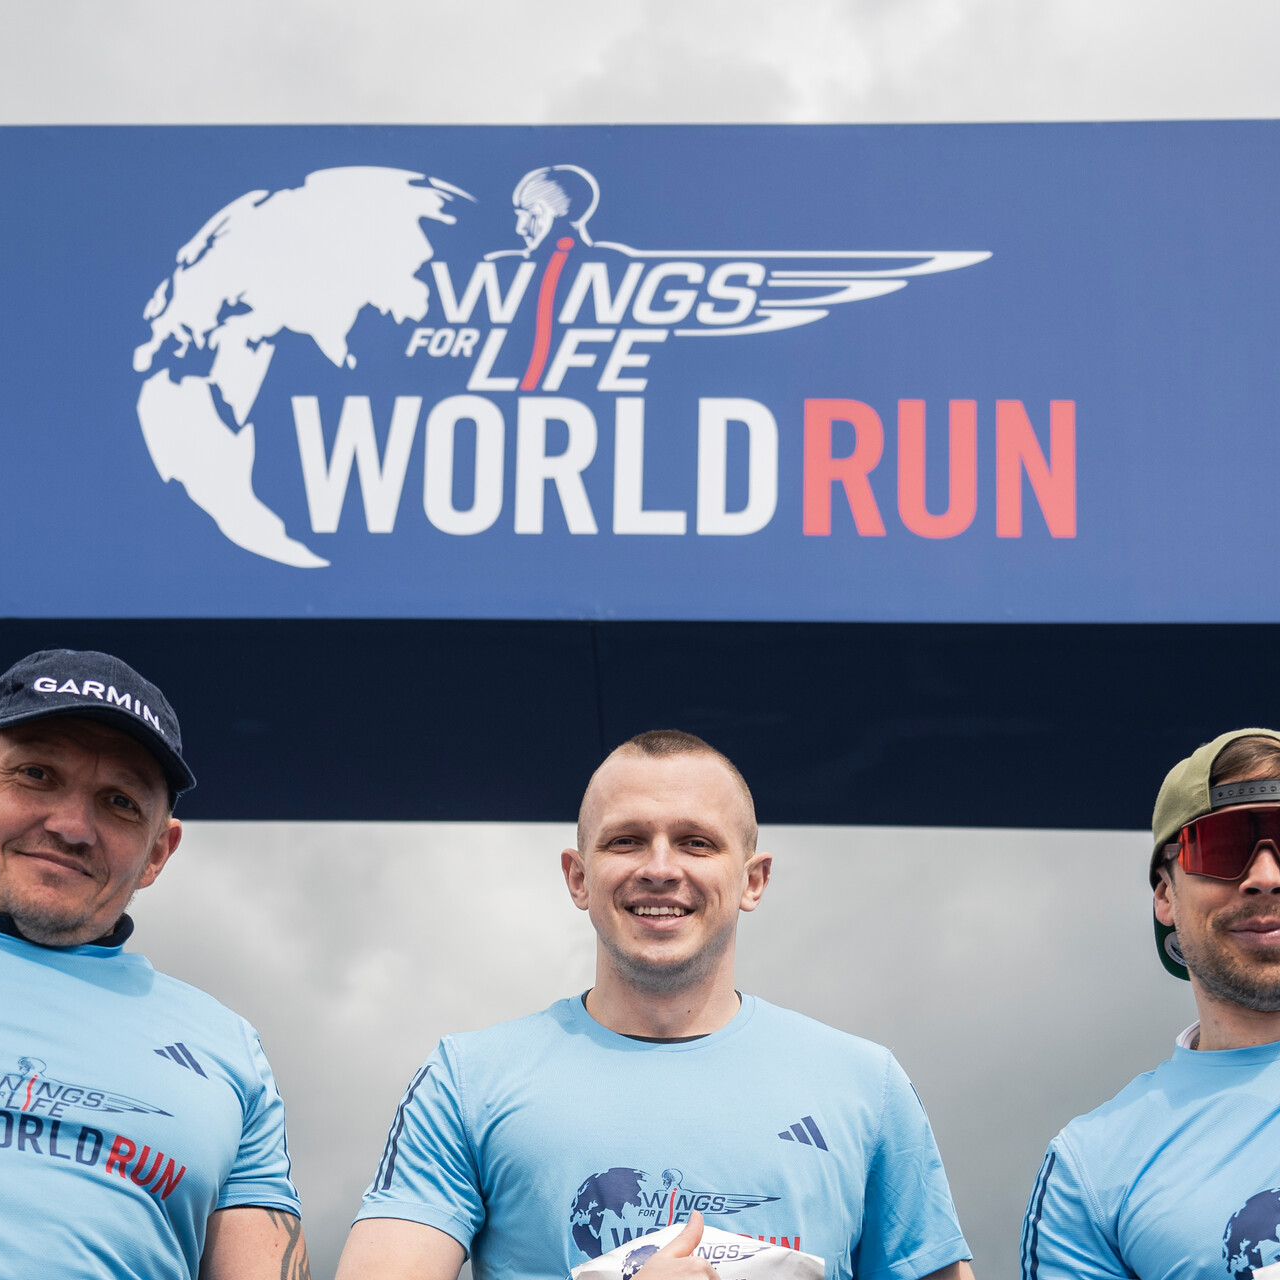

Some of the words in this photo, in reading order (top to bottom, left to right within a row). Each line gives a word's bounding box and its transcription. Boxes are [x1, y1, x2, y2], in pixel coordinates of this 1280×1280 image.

[406, 328, 478, 357] FOR
[467, 328, 668, 392] LIFE
[33, 675, 160, 732] GARMIN
[5, 1091, 70, 1118] LIFE
[637, 1208, 656, 1218] FOR
[642, 1188, 727, 1212] WINGS
